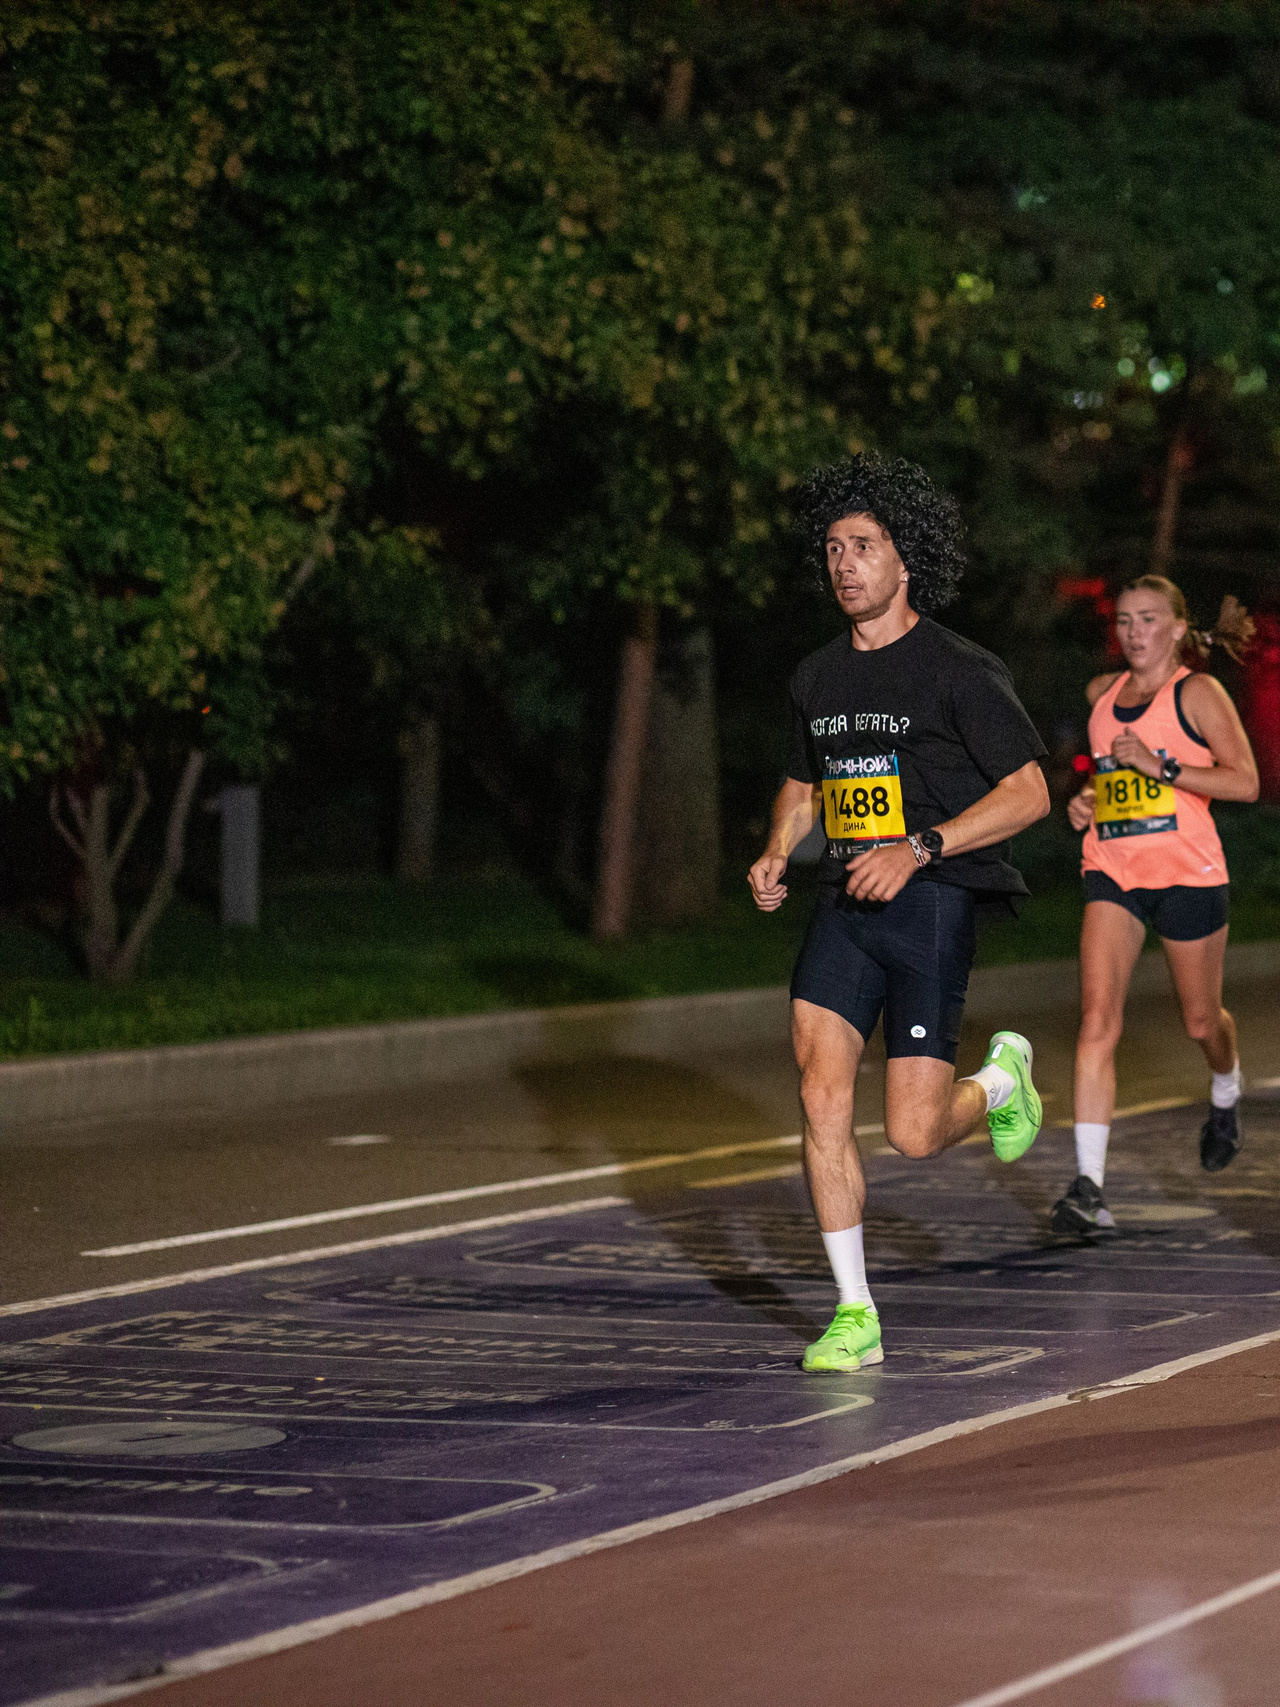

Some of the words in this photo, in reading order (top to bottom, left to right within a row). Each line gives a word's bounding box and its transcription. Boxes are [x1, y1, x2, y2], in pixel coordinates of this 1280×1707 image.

[810, 715, 848, 736] КОГДА
[855, 713, 910, 734] БЕГАТЬ?
[831, 786, 890, 820] 1488
[1105, 777, 1161, 805] 1818
[843, 822, 866, 832] ДИНА
